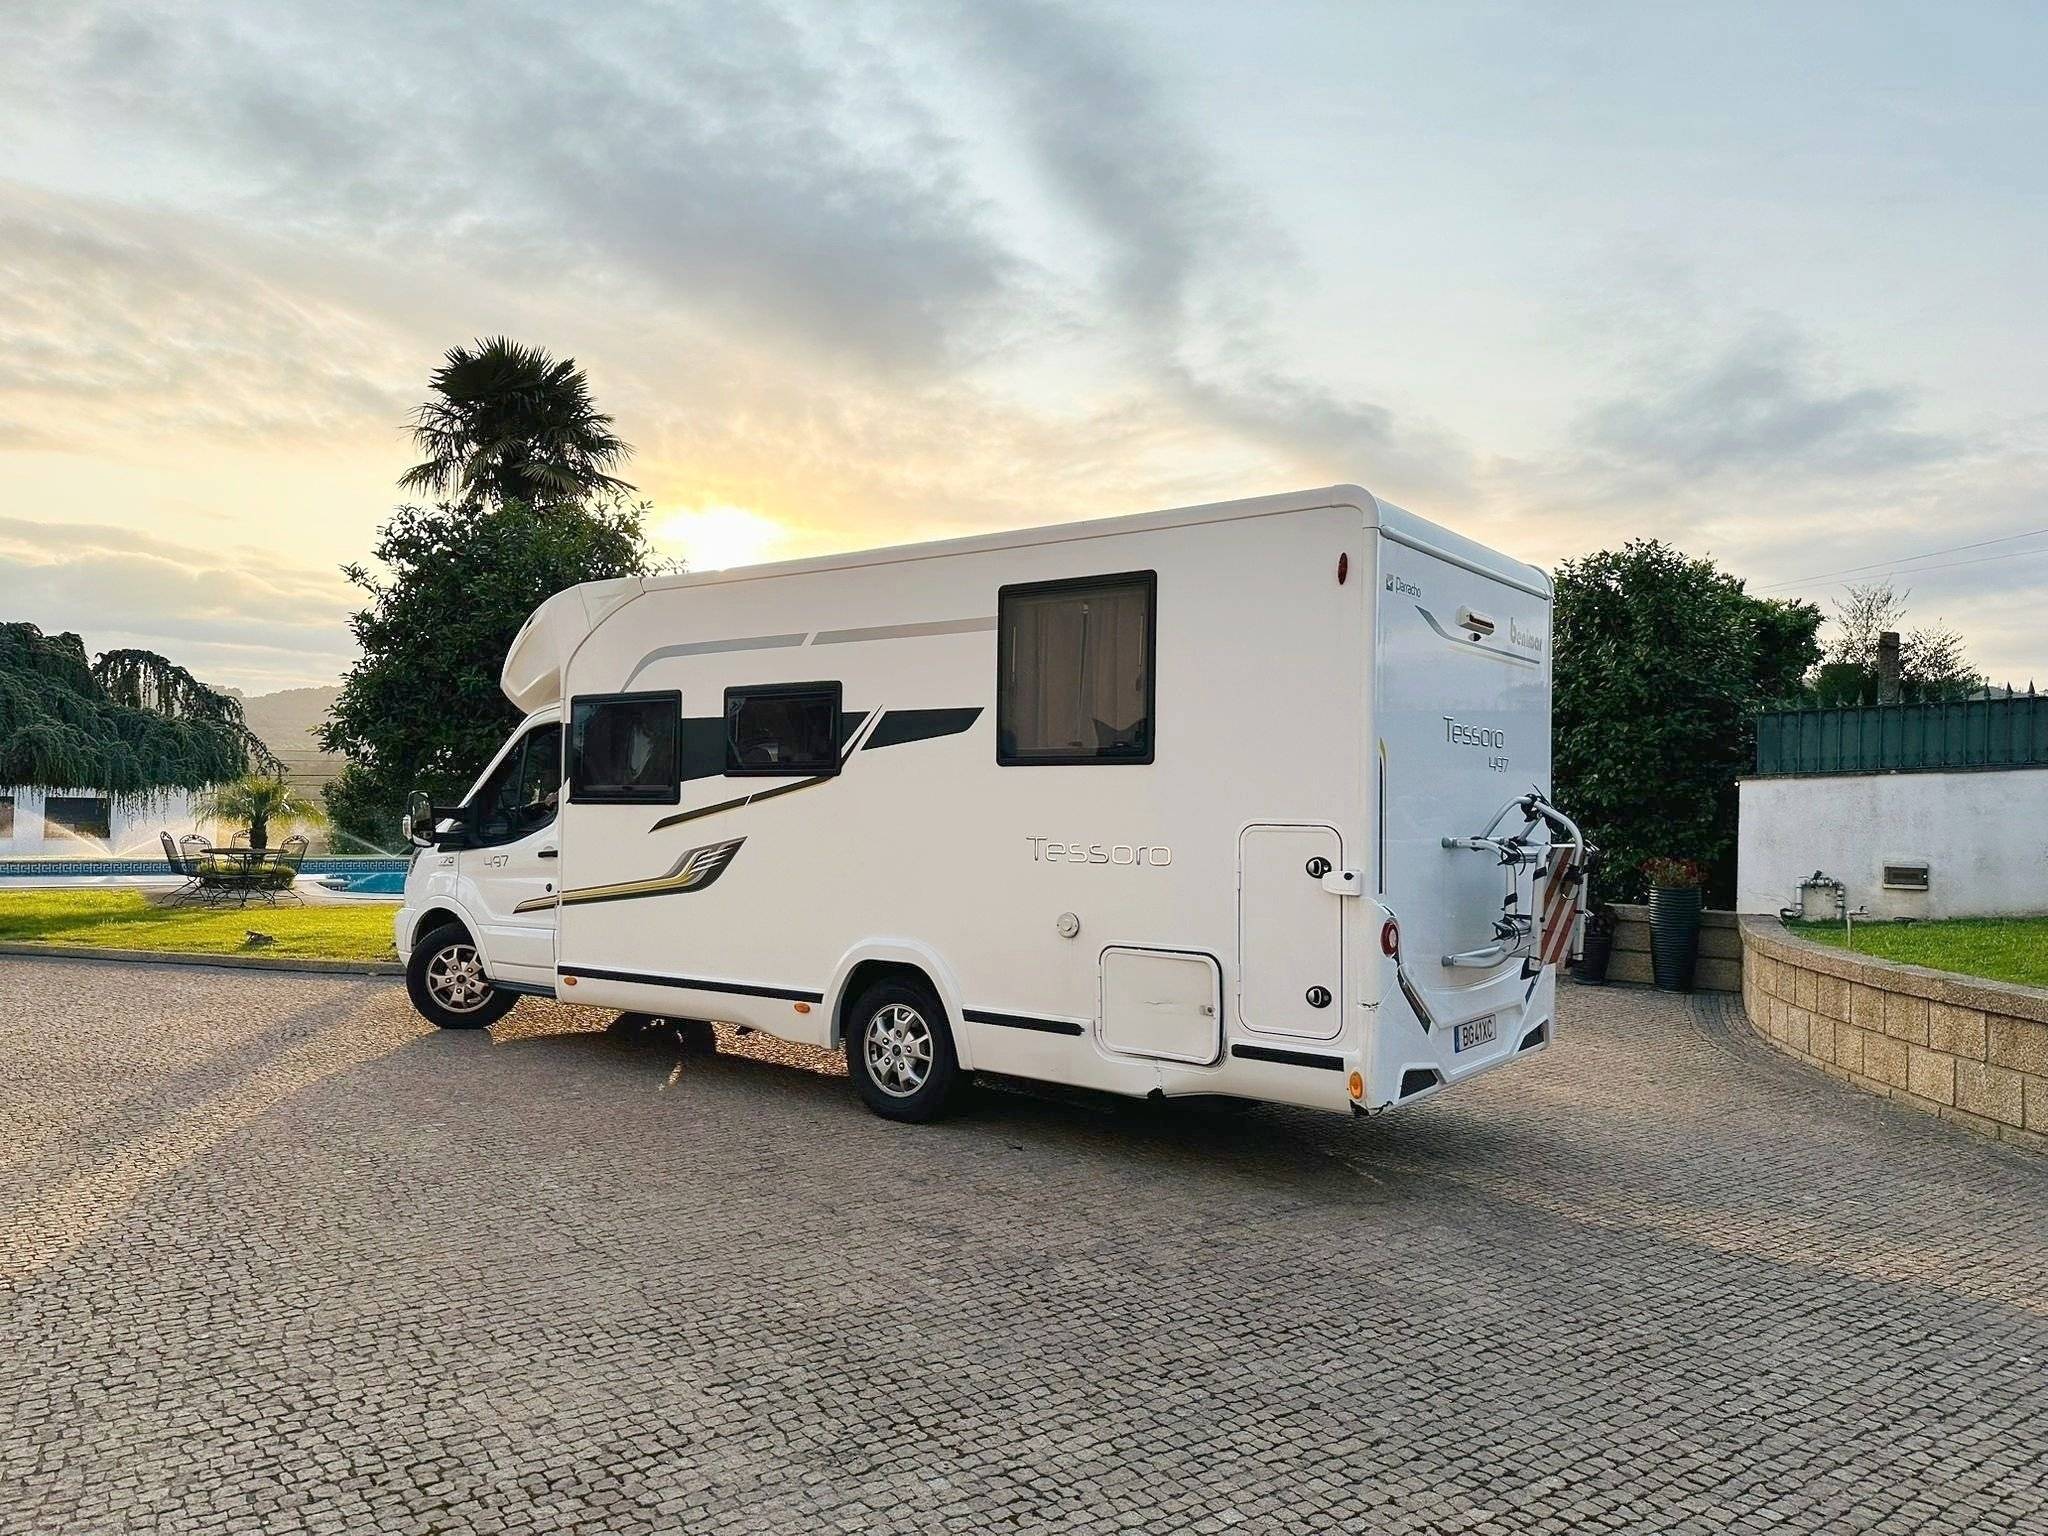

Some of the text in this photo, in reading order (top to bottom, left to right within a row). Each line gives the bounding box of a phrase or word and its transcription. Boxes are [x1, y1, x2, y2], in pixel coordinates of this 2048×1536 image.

[1443, 715, 1504, 749] Tessoro
[1488, 756, 1509, 773] 497
[483, 854, 509, 868] 497
[1026, 836, 1172, 866] Tessoro
